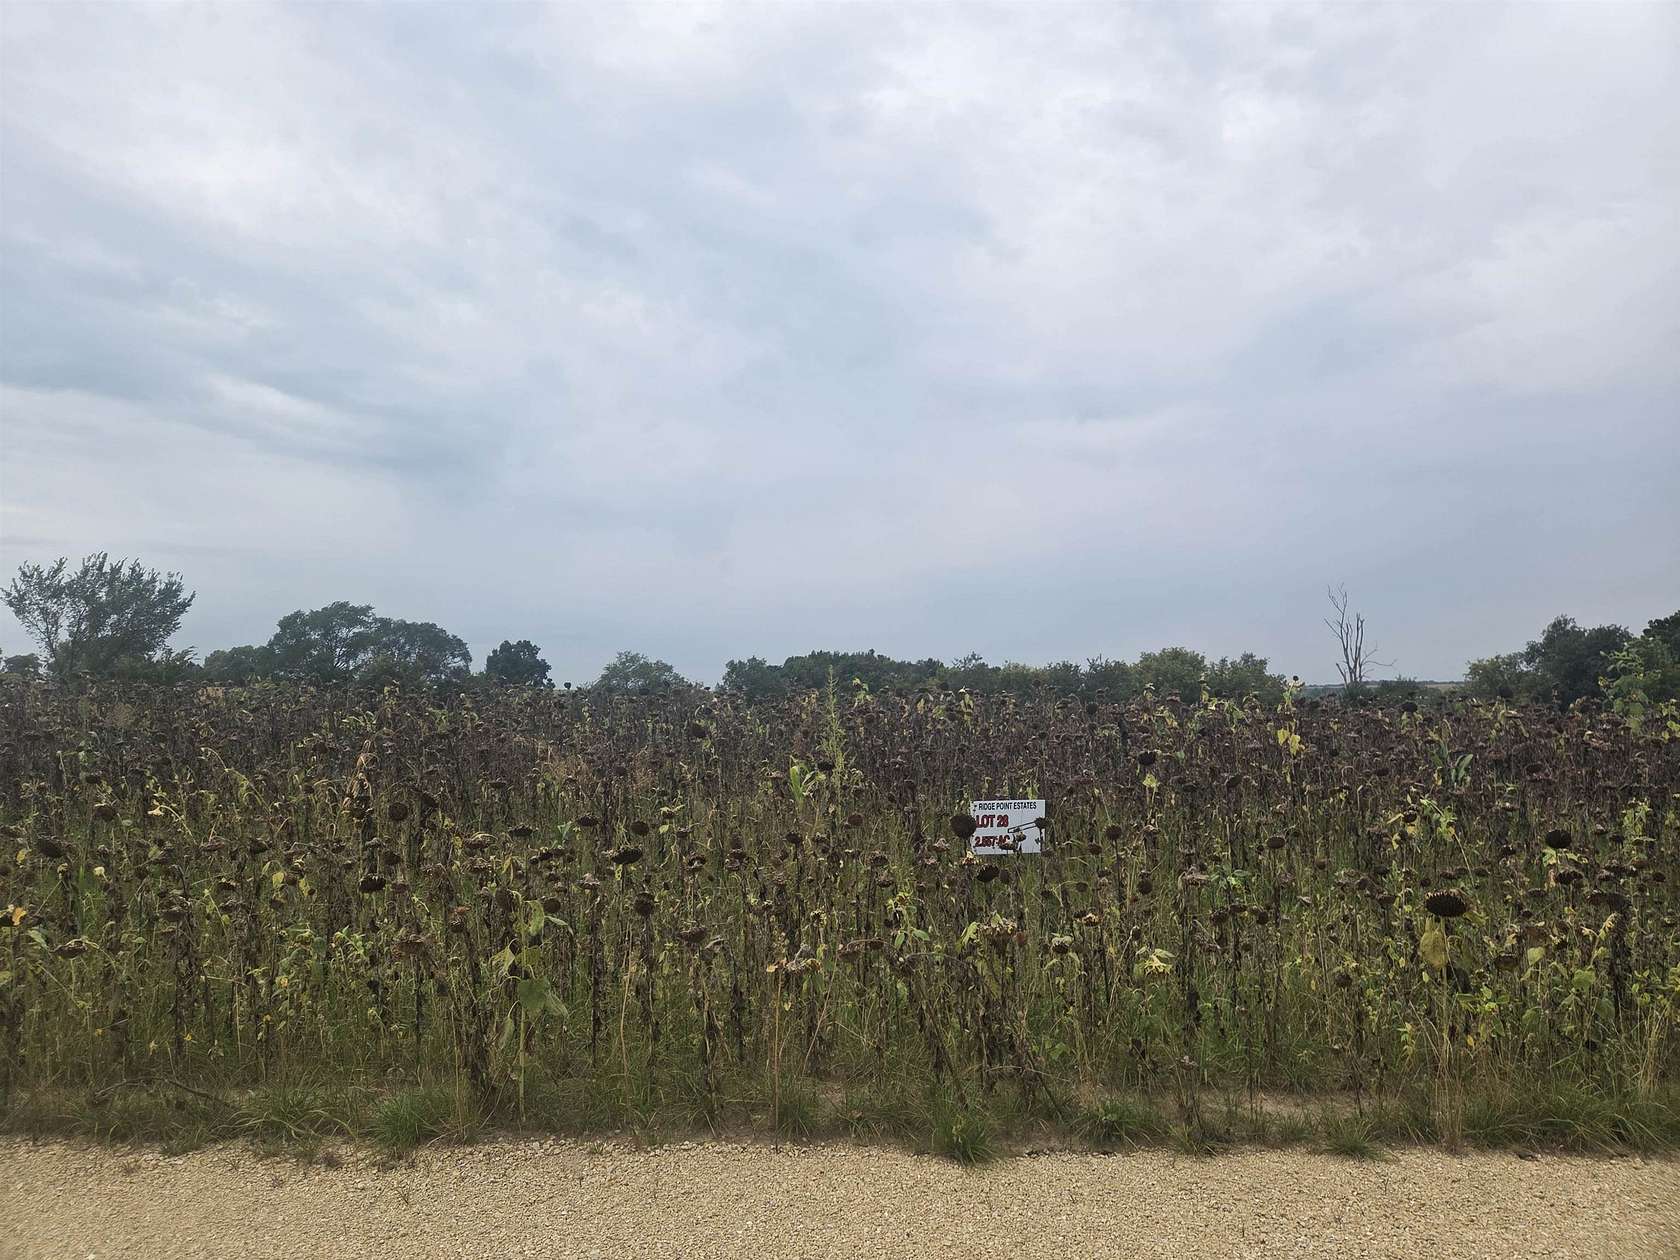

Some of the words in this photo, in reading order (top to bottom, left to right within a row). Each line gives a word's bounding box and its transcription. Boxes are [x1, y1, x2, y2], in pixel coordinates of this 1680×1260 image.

[996, 802, 1012, 810] POINT
[1014, 801, 1037, 809] ESTATES
[976, 814, 995, 827] LOT
